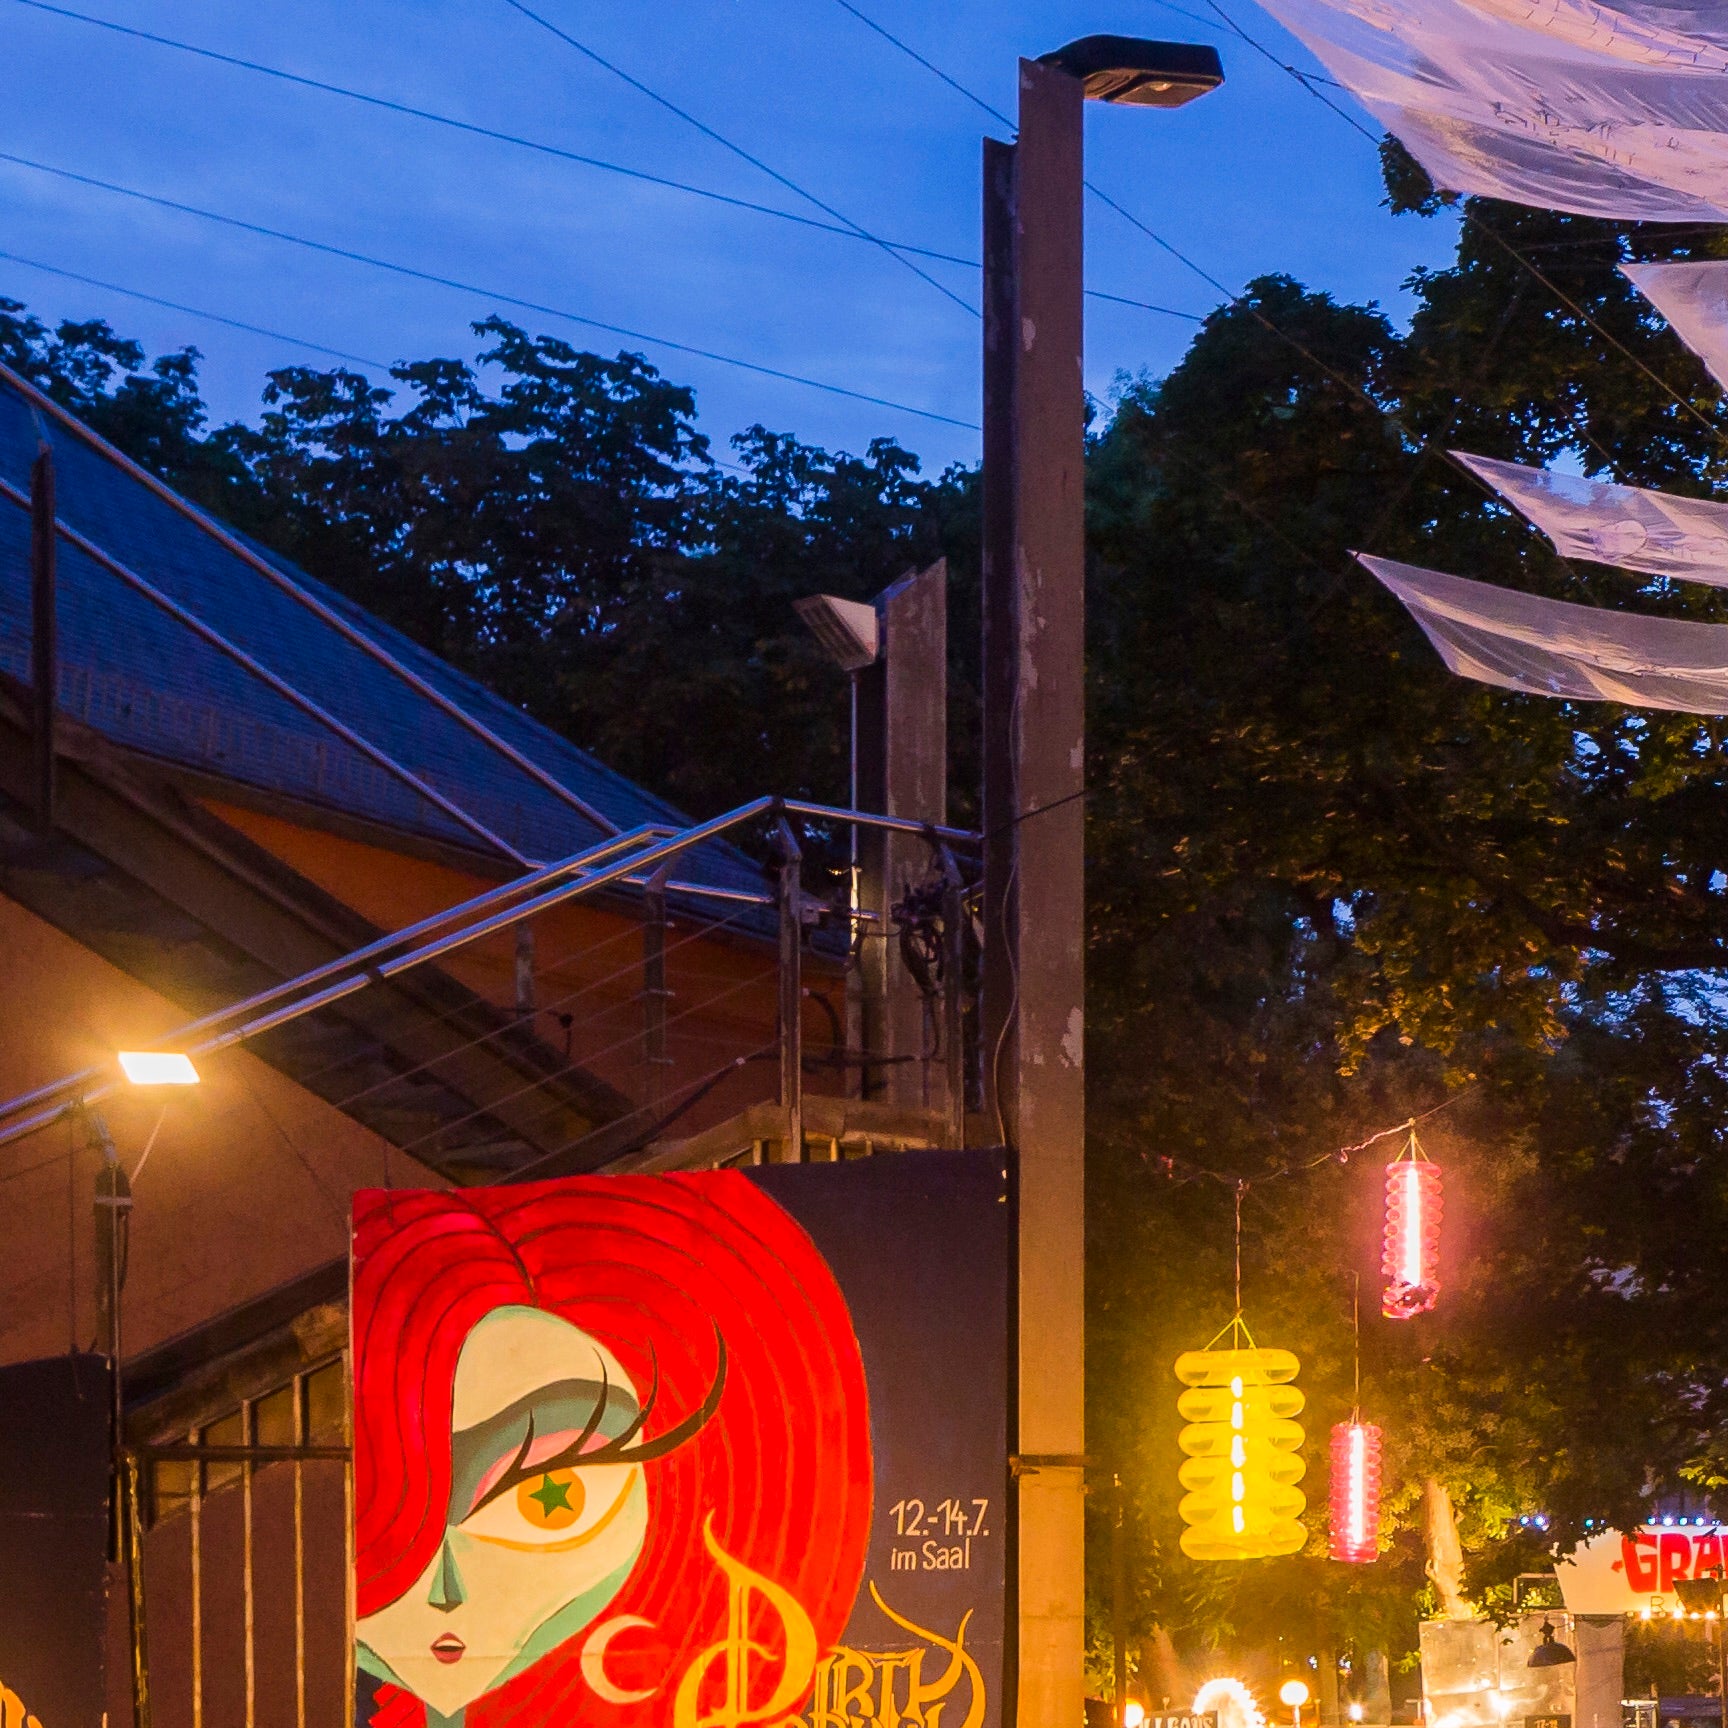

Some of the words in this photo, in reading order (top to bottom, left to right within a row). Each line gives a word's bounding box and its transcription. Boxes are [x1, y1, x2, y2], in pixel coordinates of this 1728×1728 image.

[888, 1498, 990, 1537] 12.-14.7.
[890, 1546, 917, 1571] im
[922, 1538, 970, 1571] Saal
